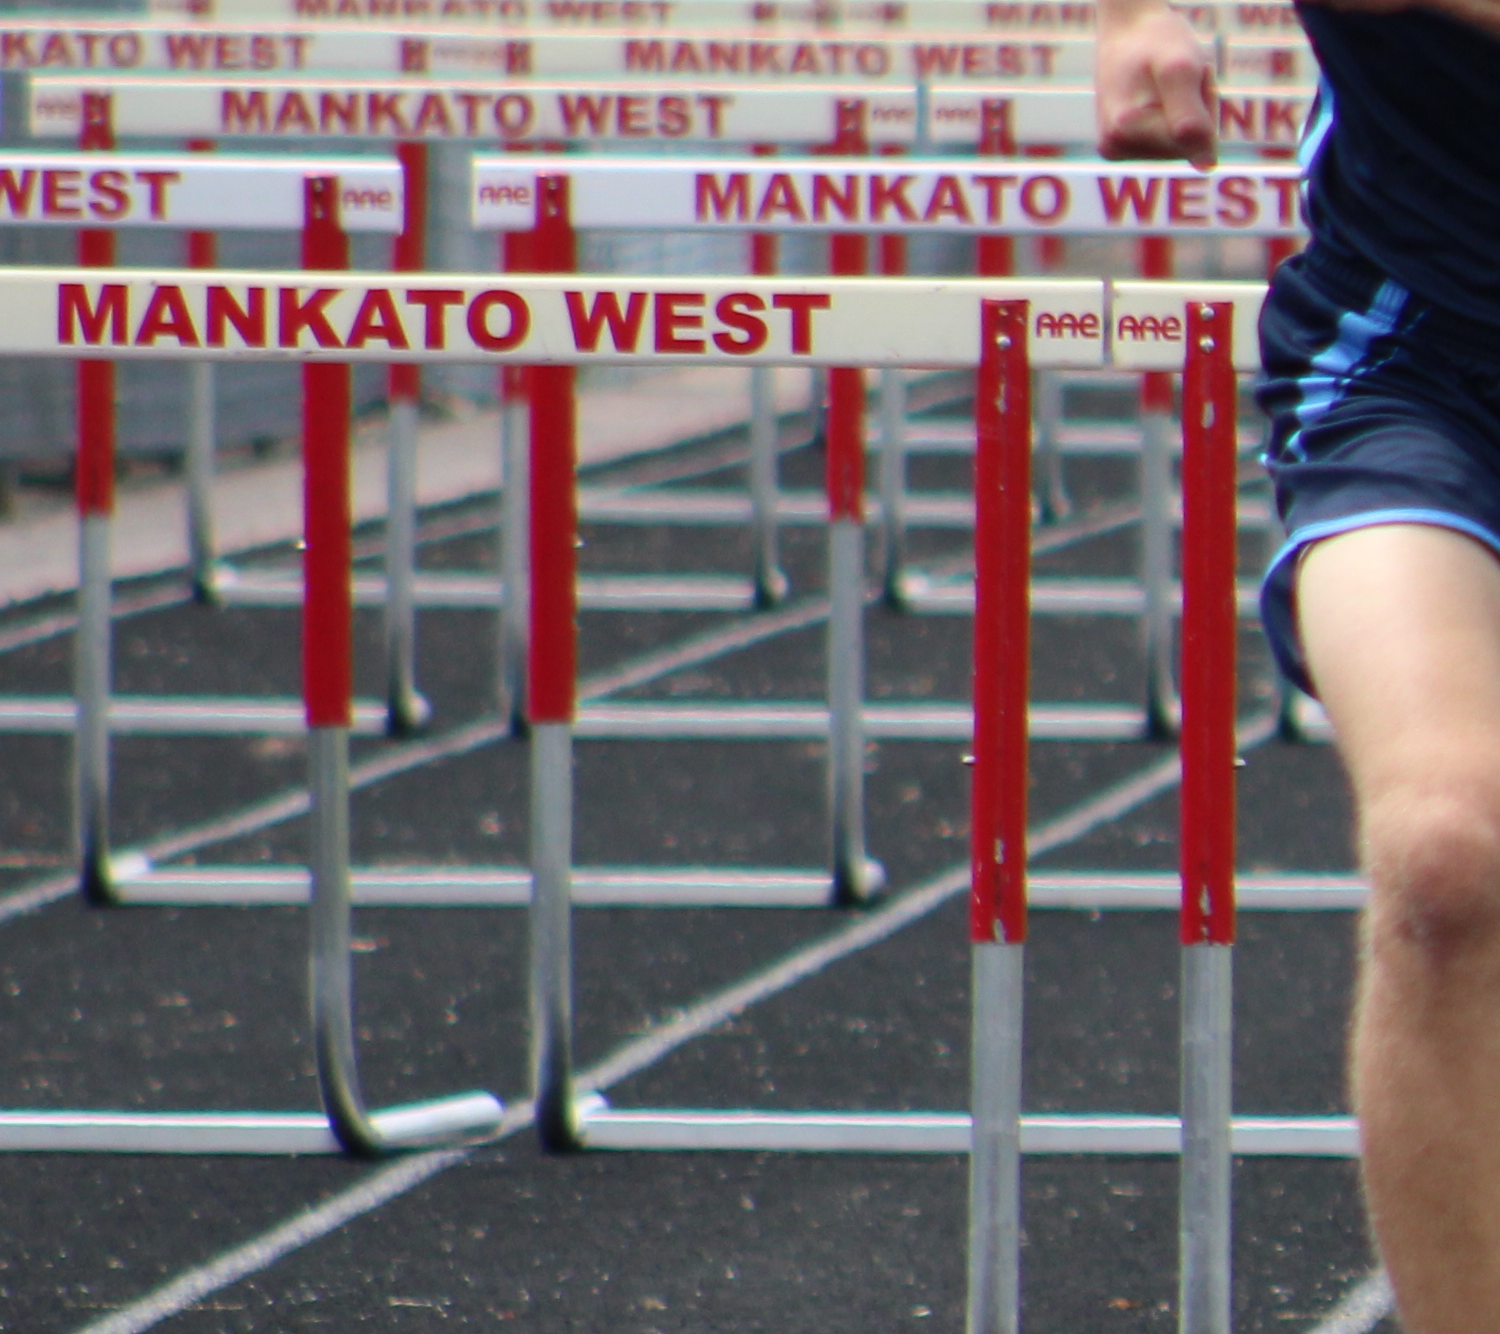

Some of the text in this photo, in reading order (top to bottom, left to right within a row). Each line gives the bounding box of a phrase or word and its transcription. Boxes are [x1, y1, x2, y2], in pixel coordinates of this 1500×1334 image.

[165, 34, 311, 70] WEST
[623, 39, 1058, 77] MANKATO WEST
[220, 90, 734, 139] MANKATO WEST
[694, 172, 1300, 228] MANKATO WEST
[57, 282, 832, 355] MANKATO WEST
